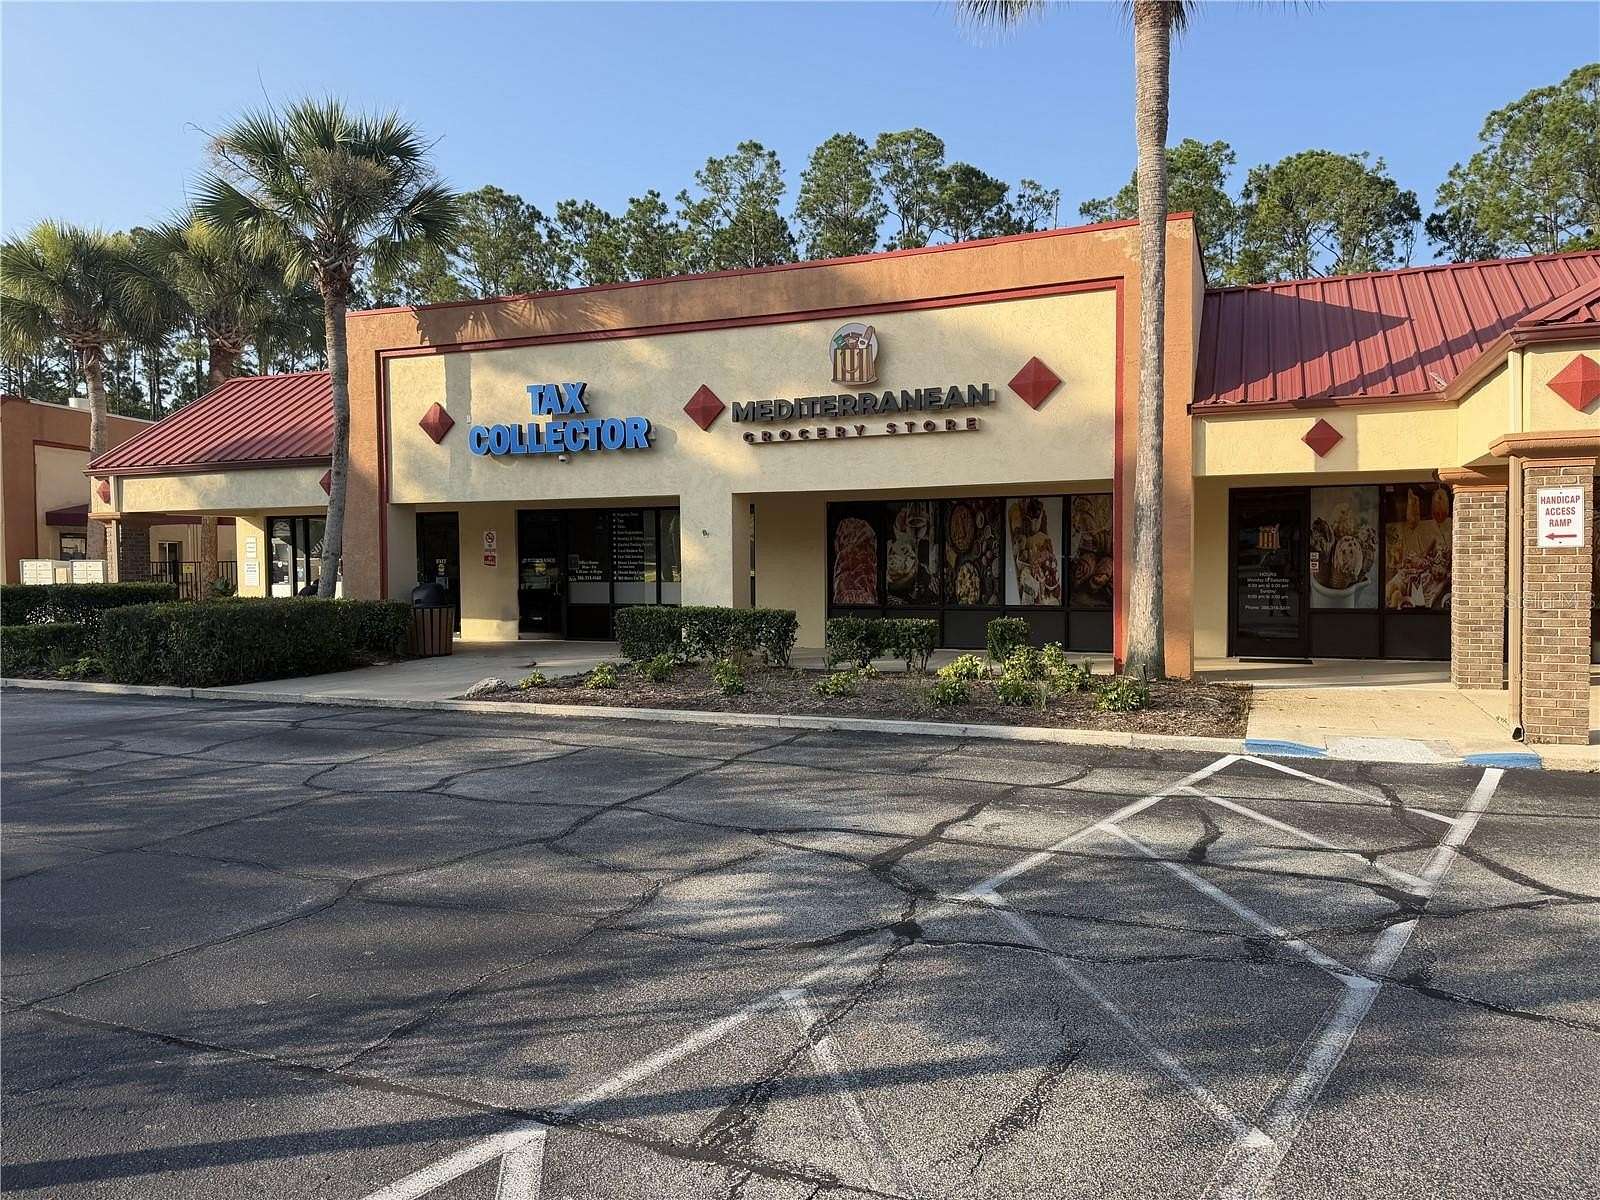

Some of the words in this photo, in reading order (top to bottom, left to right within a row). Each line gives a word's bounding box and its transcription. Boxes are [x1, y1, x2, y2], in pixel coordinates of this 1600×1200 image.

[527, 381, 588, 416] TAX
[732, 383, 992, 422] MEDITERRANEAN
[468, 415, 651, 456] COLLECTOR
[743, 424, 865, 443] GROCERY
[886, 417, 980, 435] STORE
[1540, 495, 1581, 505] HANDICAP
[1545, 507, 1576, 516] ACCESS
[1549, 518, 1572, 527] RAMP
